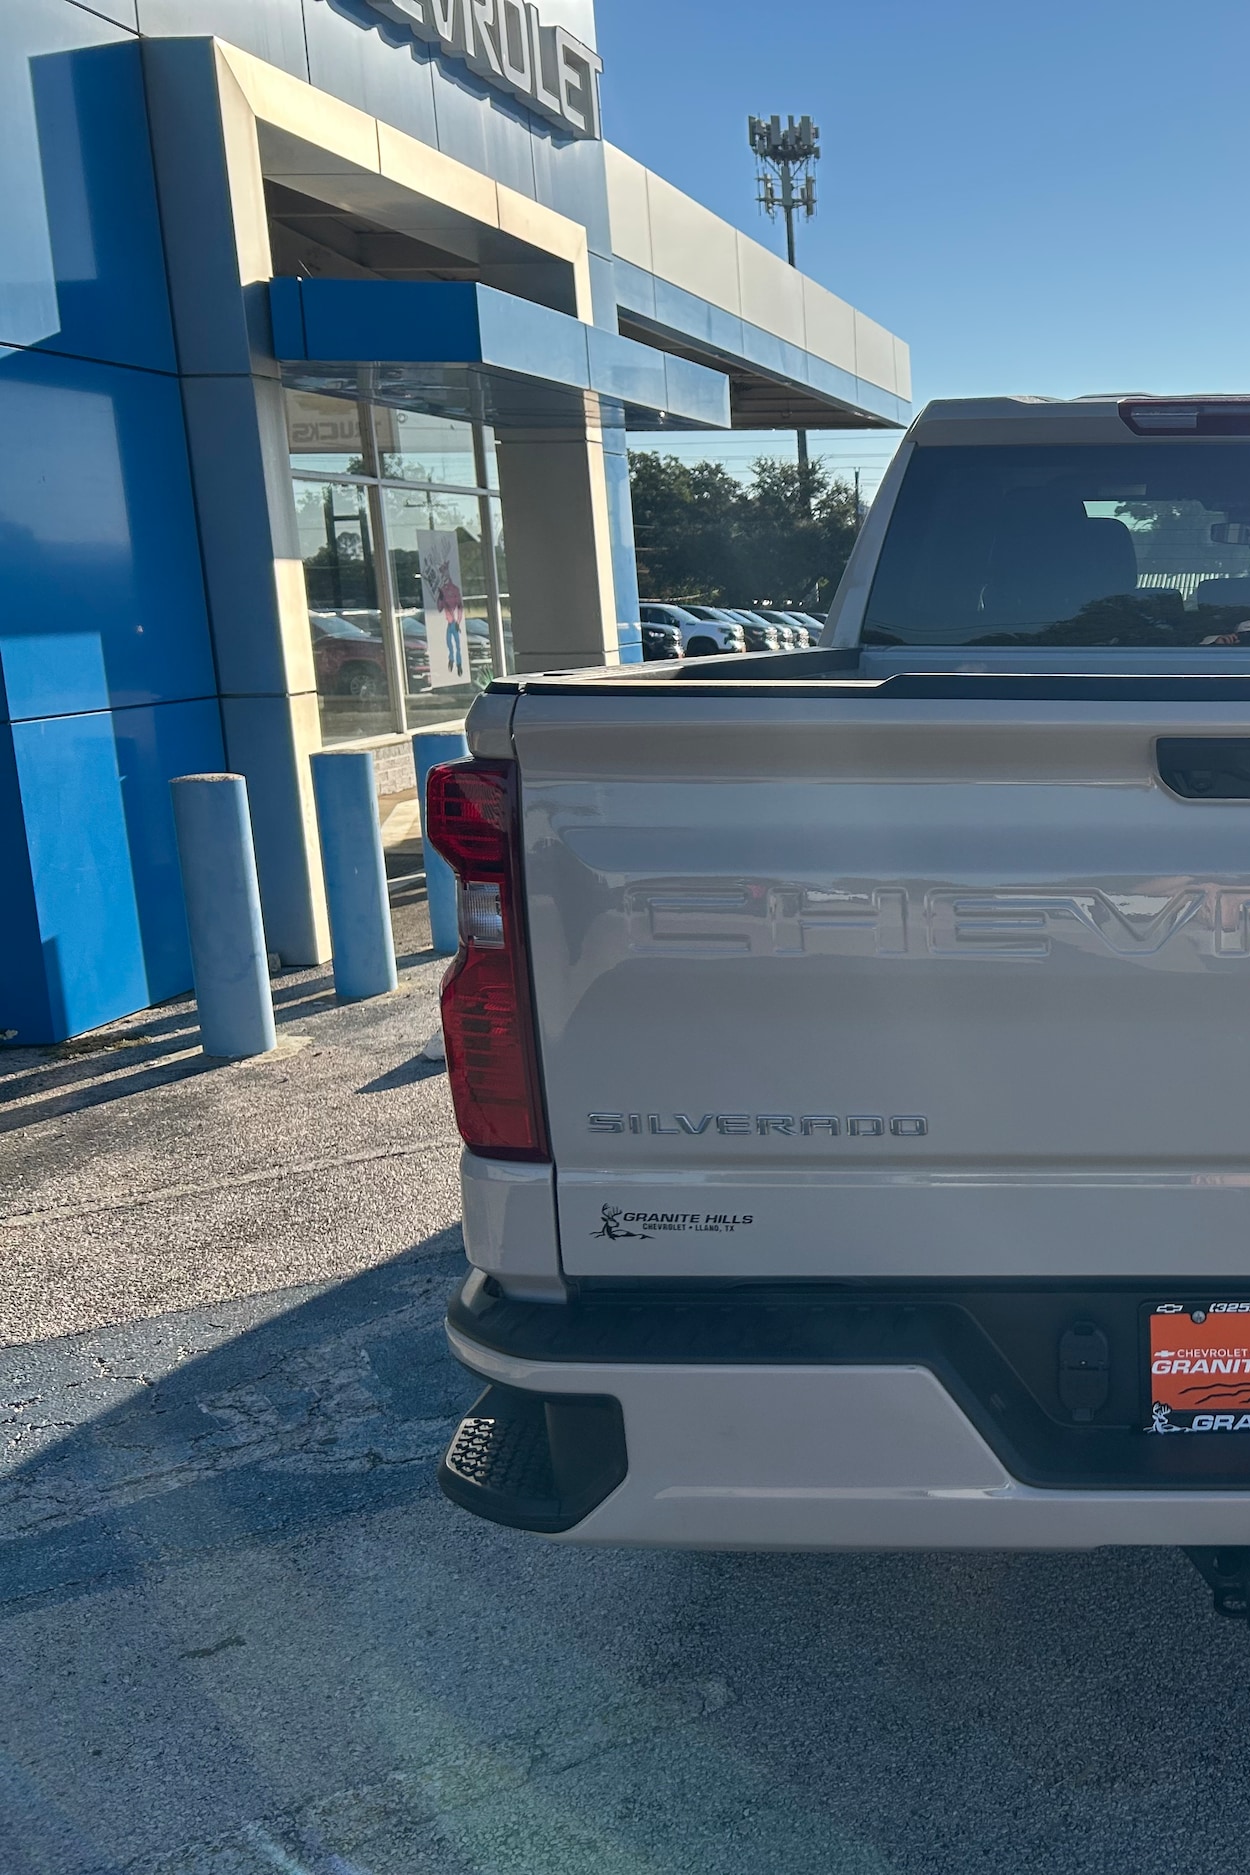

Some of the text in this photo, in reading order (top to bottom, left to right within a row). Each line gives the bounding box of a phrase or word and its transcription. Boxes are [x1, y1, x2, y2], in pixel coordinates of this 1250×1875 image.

[587, 1112, 929, 1137] SILVERADO
[623, 1212, 754, 1224] GRANITE HILLS
[642, 1223, 687, 1231] CHEVROLET
[1177, 1348, 1248, 1358] CHEVROLET
